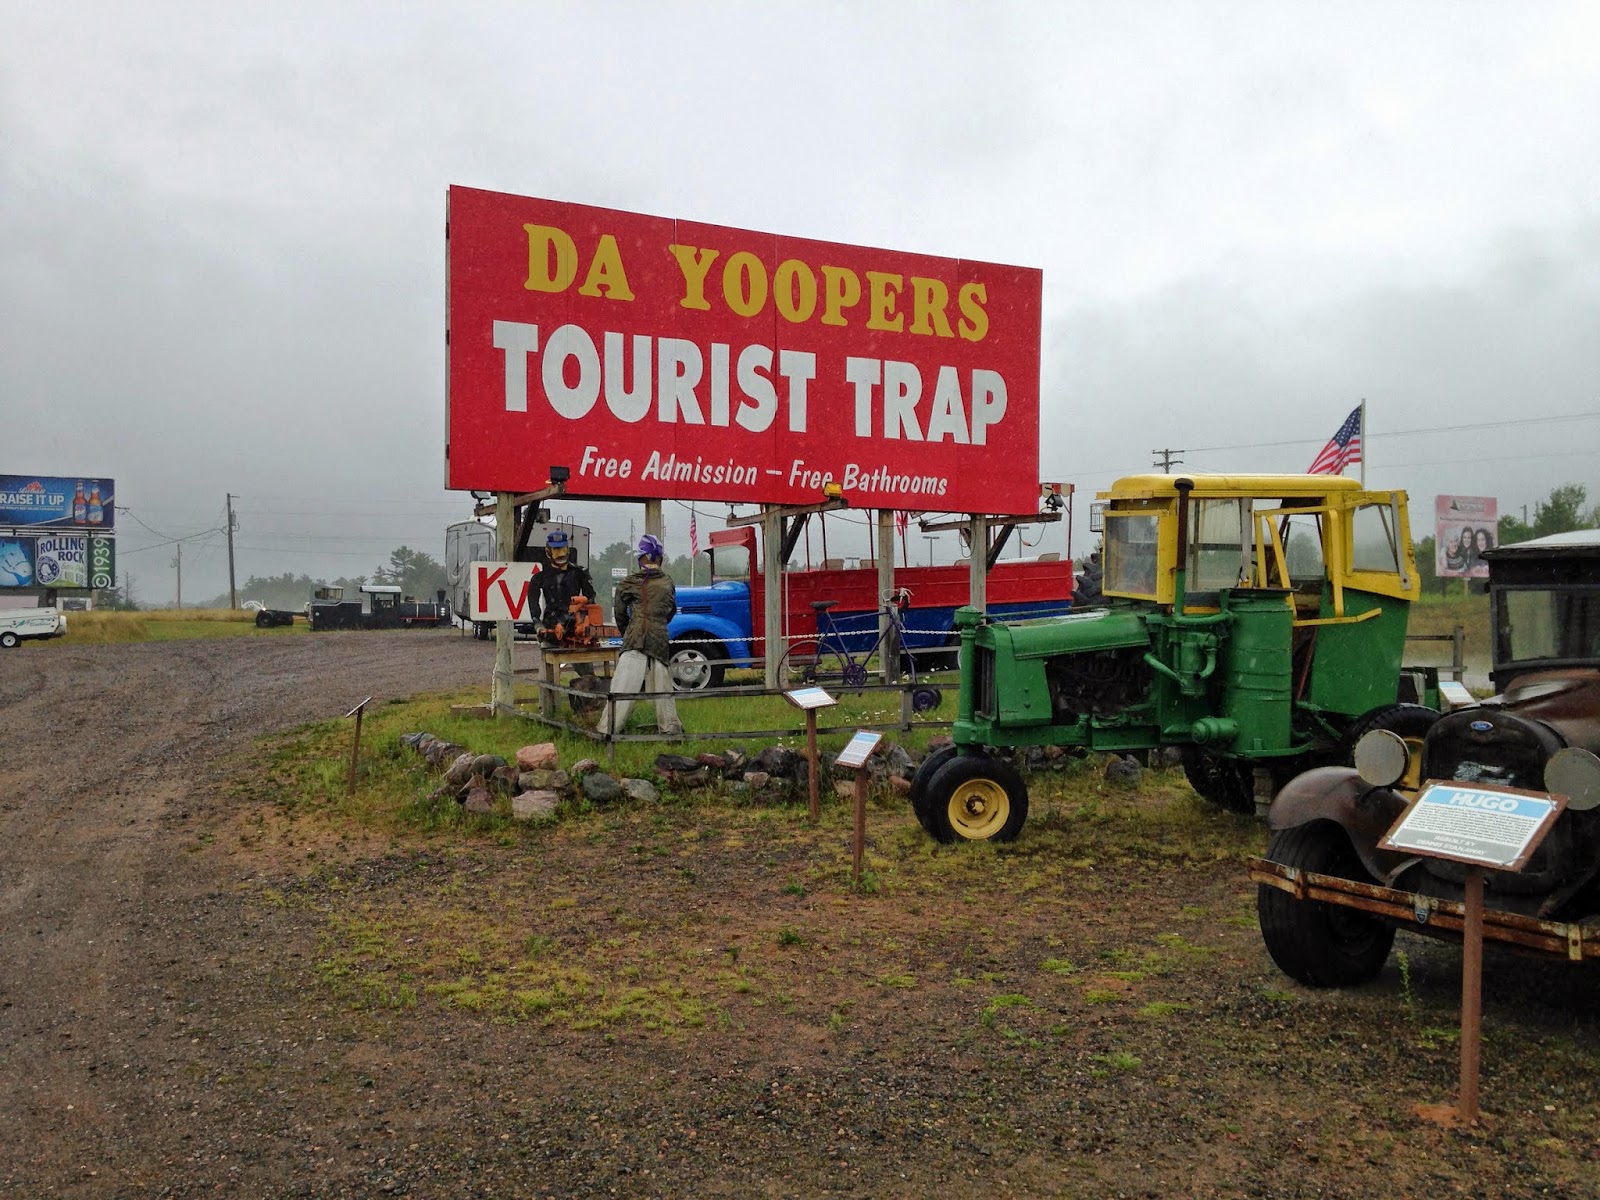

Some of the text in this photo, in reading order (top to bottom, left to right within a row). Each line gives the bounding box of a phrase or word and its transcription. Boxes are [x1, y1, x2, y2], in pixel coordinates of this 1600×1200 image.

[523, 223, 989, 342] DA YOOPERS
[492, 319, 1008, 446] TOURIST TRAP
[579, 446, 632, 477] Free
[640, 450, 757, 485] Admission
[788, 460, 833, 487] Free
[842, 463, 948, 496] Bathrooms
[0, 493, 65, 506] RAISE IT UP
[40, 537, 84, 554] ROLLING
[58, 551, 85, 564] ROCK
[1449, 792, 1519, 812] HUGO
